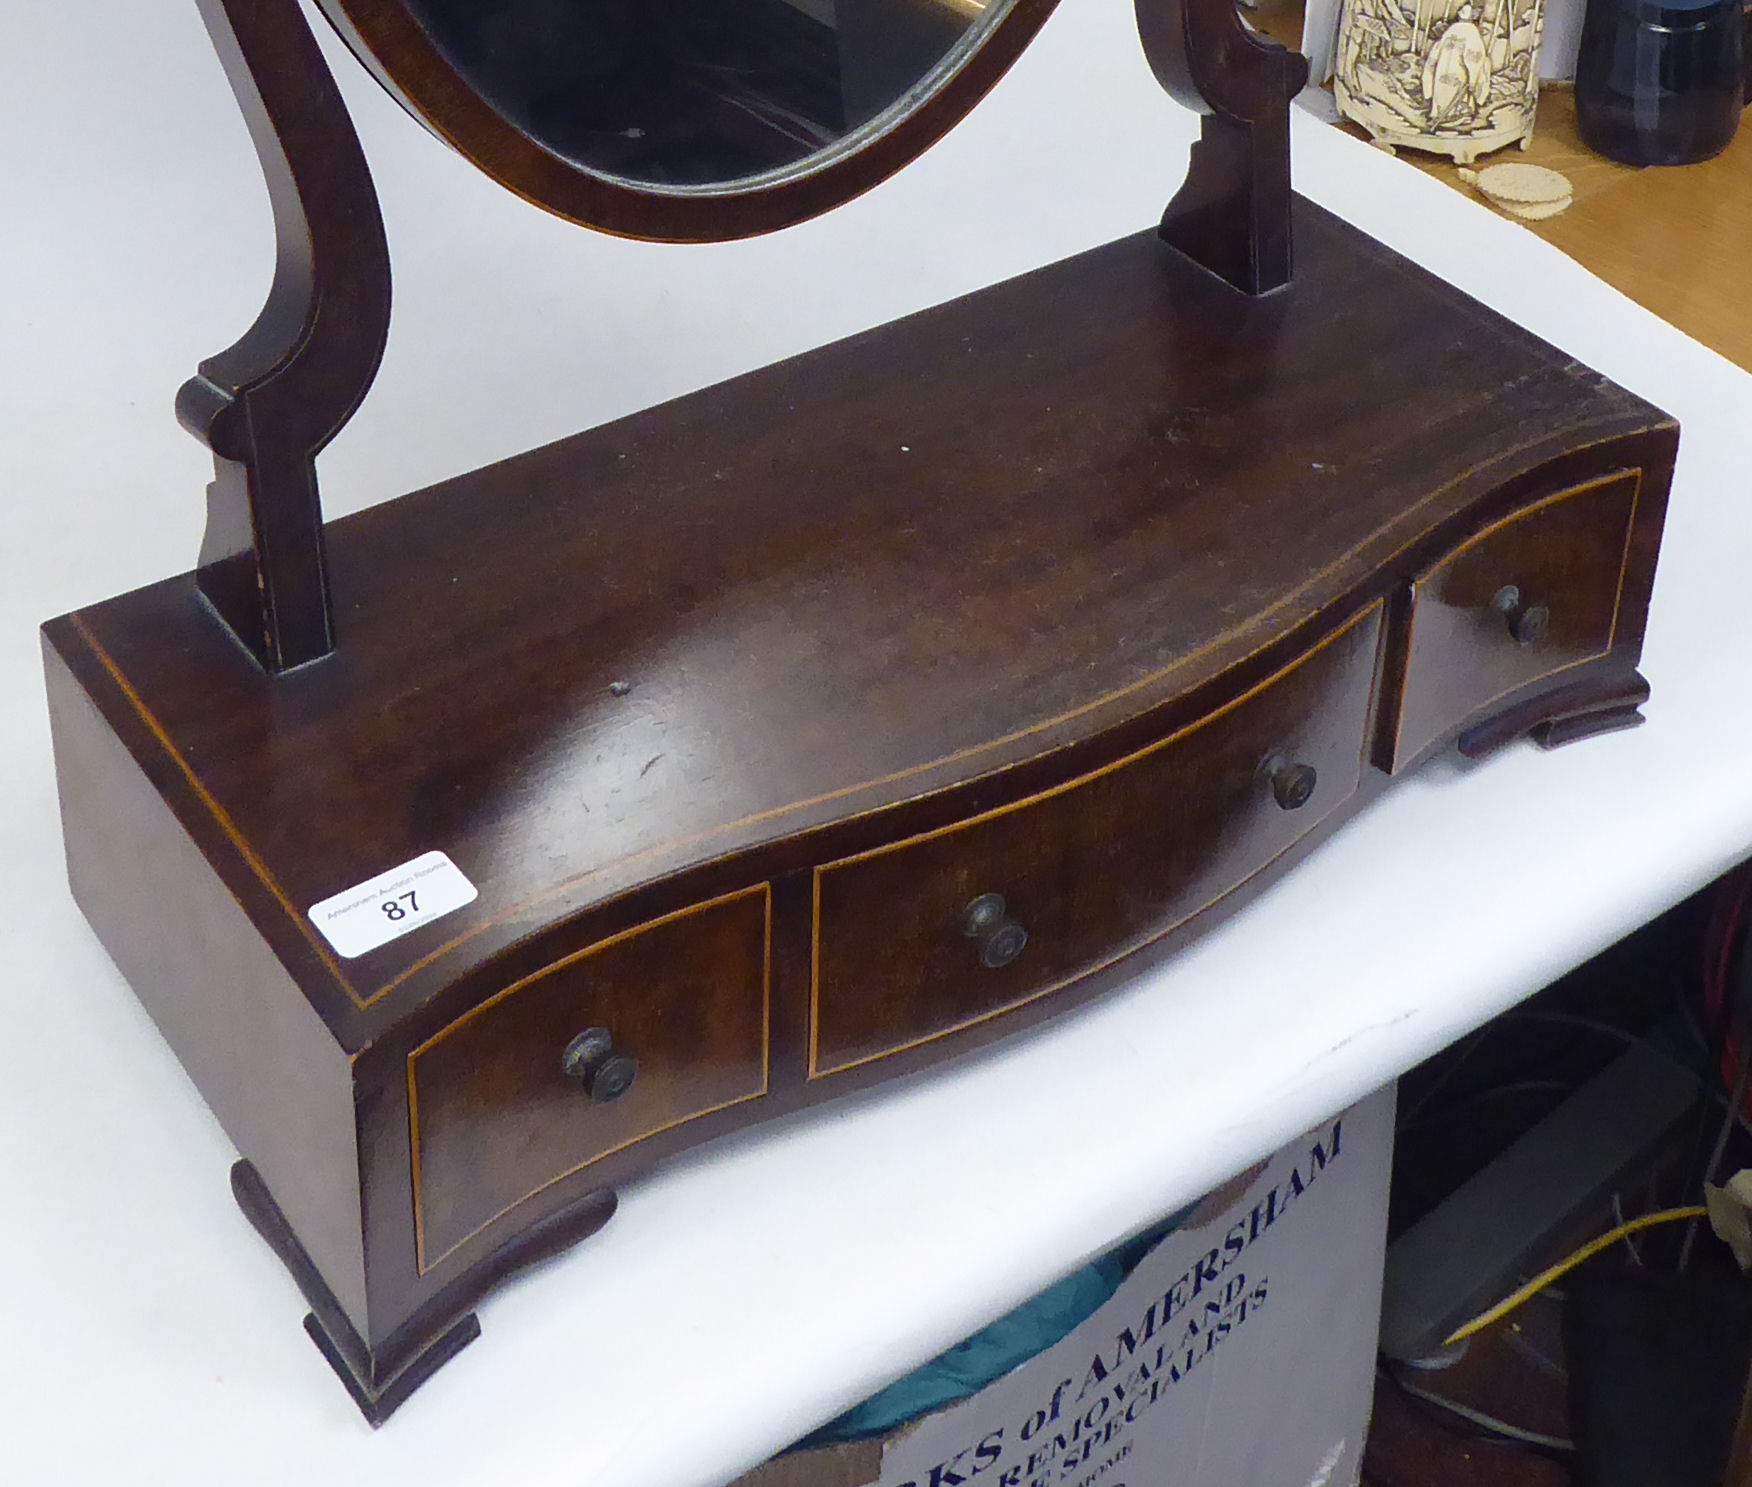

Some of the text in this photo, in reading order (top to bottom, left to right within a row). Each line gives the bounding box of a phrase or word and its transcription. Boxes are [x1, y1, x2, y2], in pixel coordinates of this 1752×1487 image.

[379, 875, 415, 896] Auction
[381, 889, 420, 921] 87
[999, 1272, 1246, 1487] REMOVAL AND
[1020, 1377, 1073, 1441] of
[1075, 1118, 1343, 1403] AMERSHAM
[1060, 1274, 1269, 1481] SPECIALISTS
